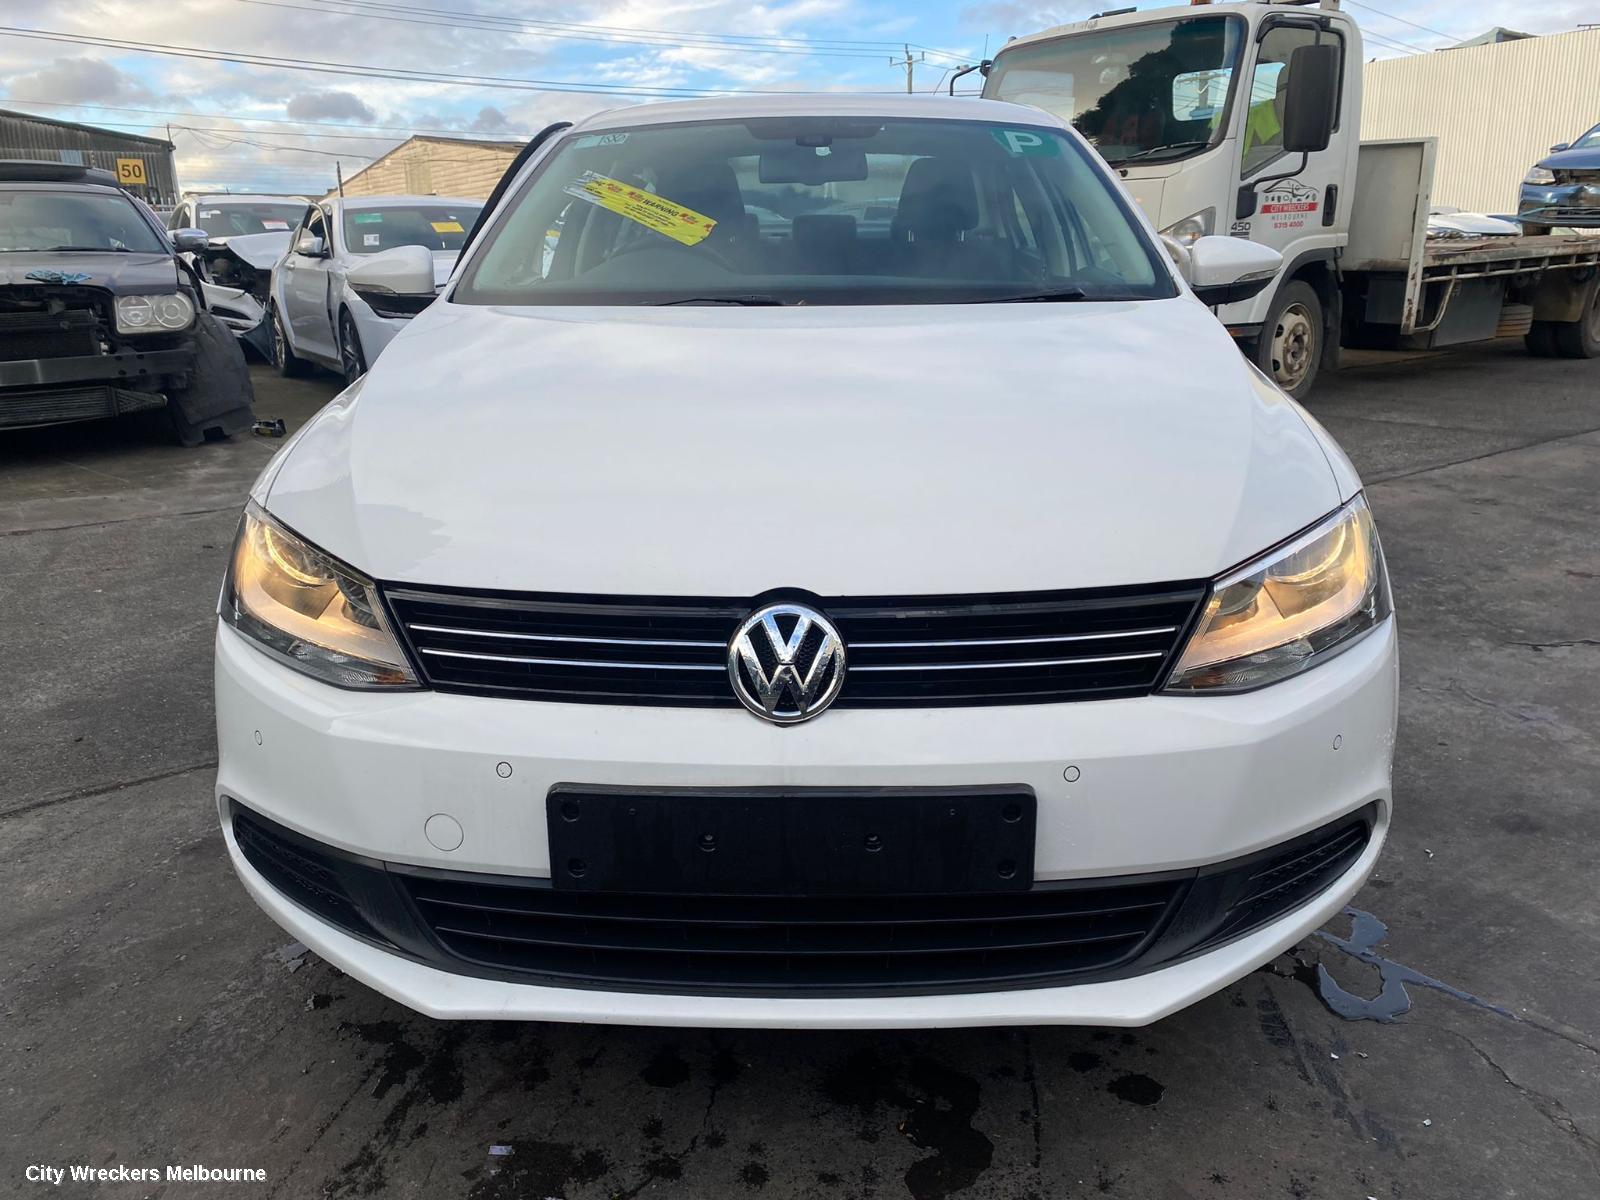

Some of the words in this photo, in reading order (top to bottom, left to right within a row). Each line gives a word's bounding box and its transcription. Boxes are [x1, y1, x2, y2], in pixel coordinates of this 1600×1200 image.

[1003, 131, 1042, 153] P
[121, 163, 142, 178] 50
[643, 199, 679, 217] WARNING
[1271, 204, 1282, 212] CITY
[1231, 222, 1251, 231] 450
[731, 606, 843, 721] VW
